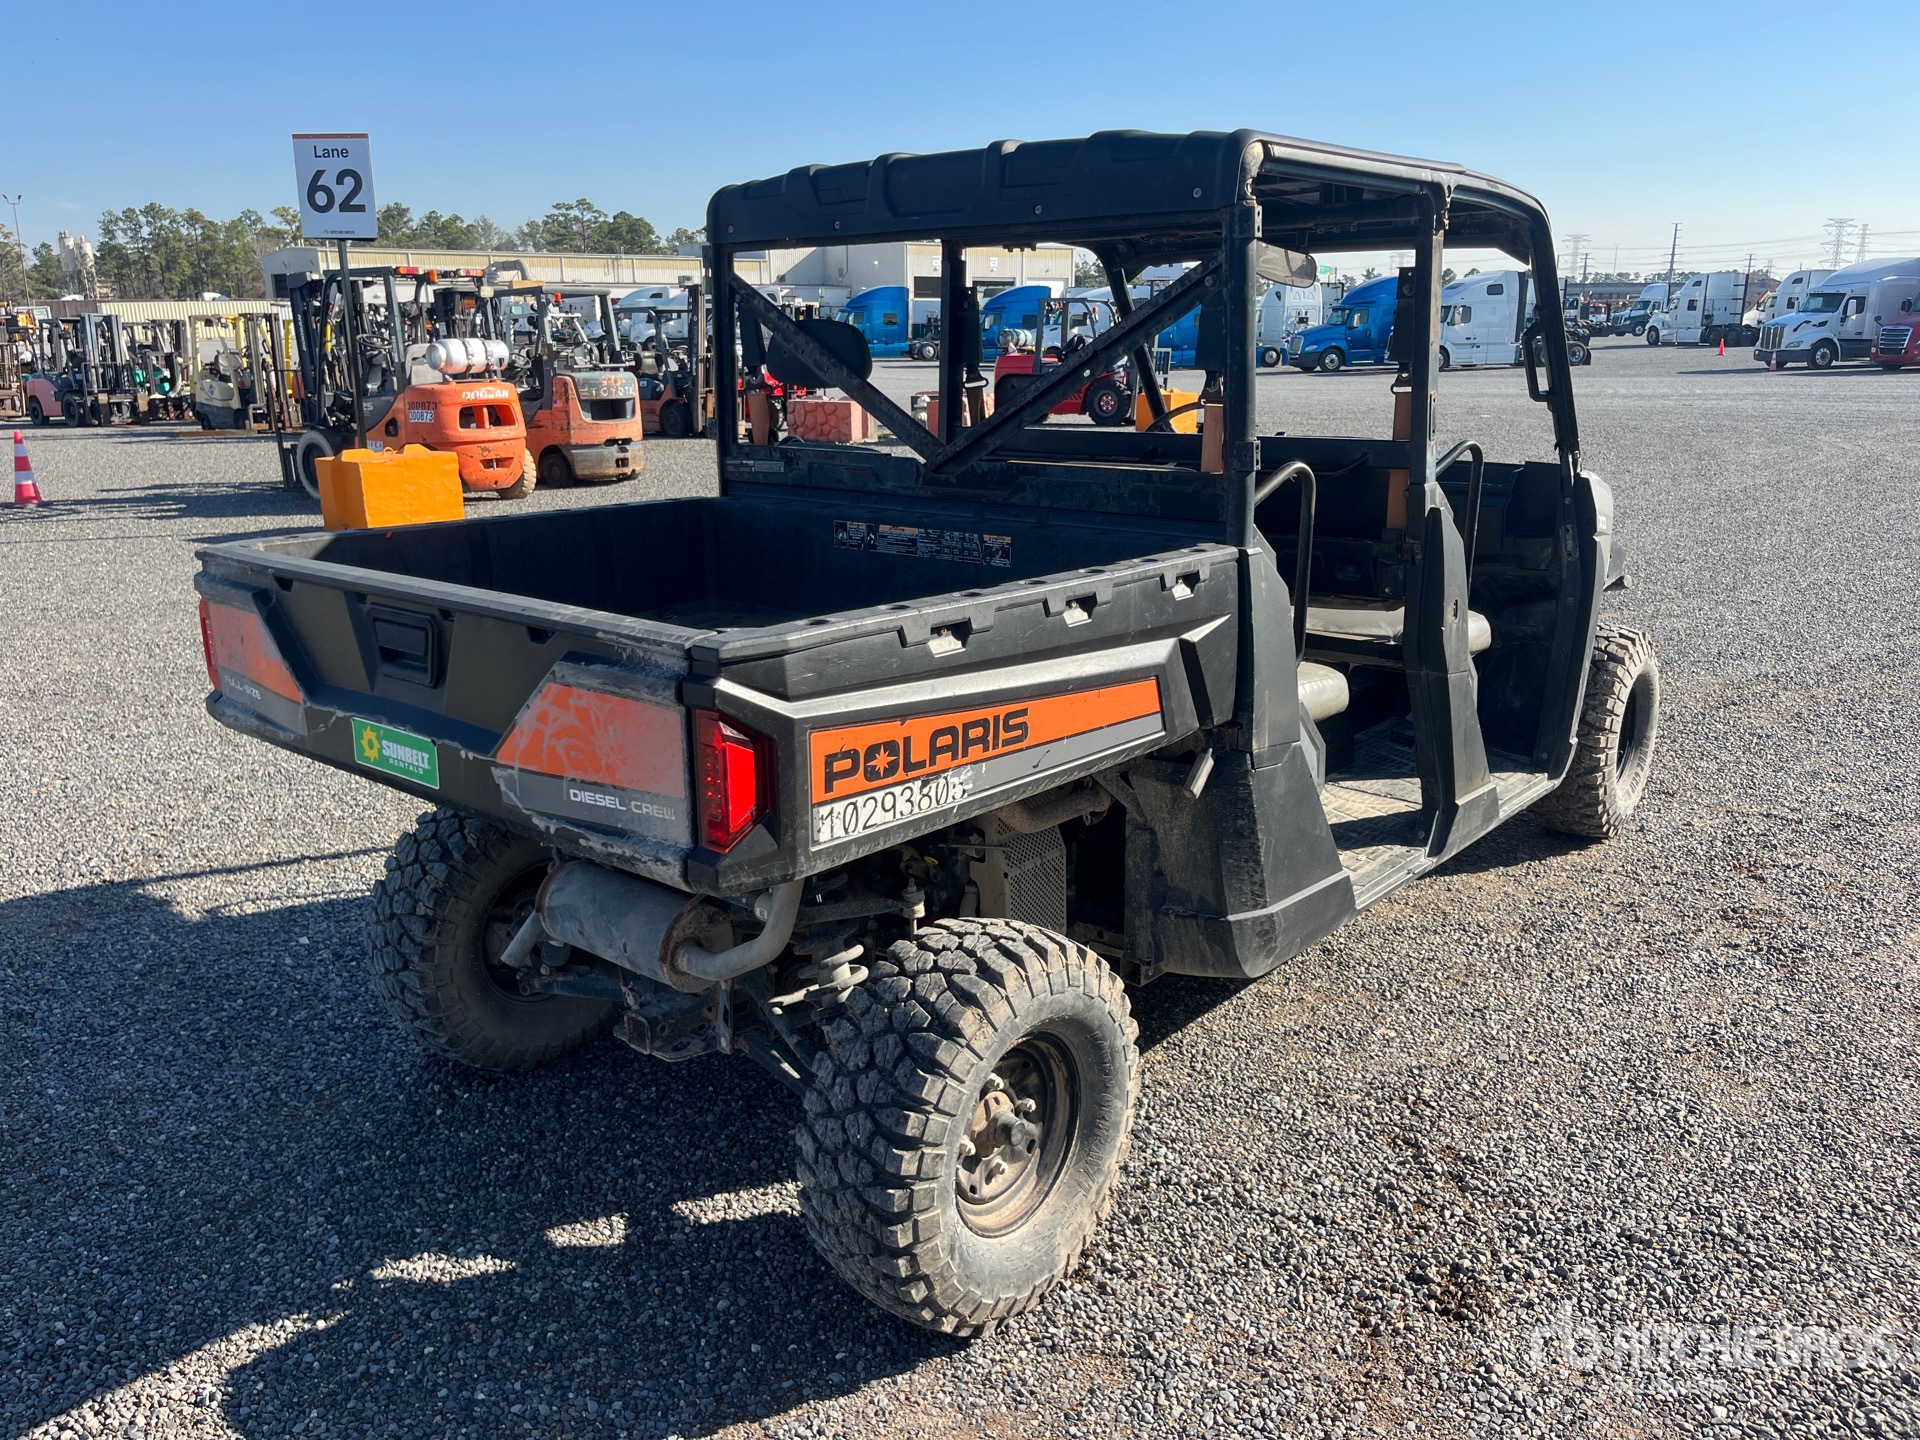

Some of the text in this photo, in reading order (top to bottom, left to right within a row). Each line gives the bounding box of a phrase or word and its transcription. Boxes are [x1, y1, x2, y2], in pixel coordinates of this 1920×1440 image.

[313, 145, 349, 158] Lane
[306, 168, 366, 213] 62
[590, 384, 636, 397] TOYOTA
[409, 411, 434, 422] 300873
[381, 740, 430, 769] SUNBELT
[824, 707, 1030, 795] POLARIS
[388, 758, 424, 775] RENTALS
[569, 788, 676, 821] DIESEL CREW
